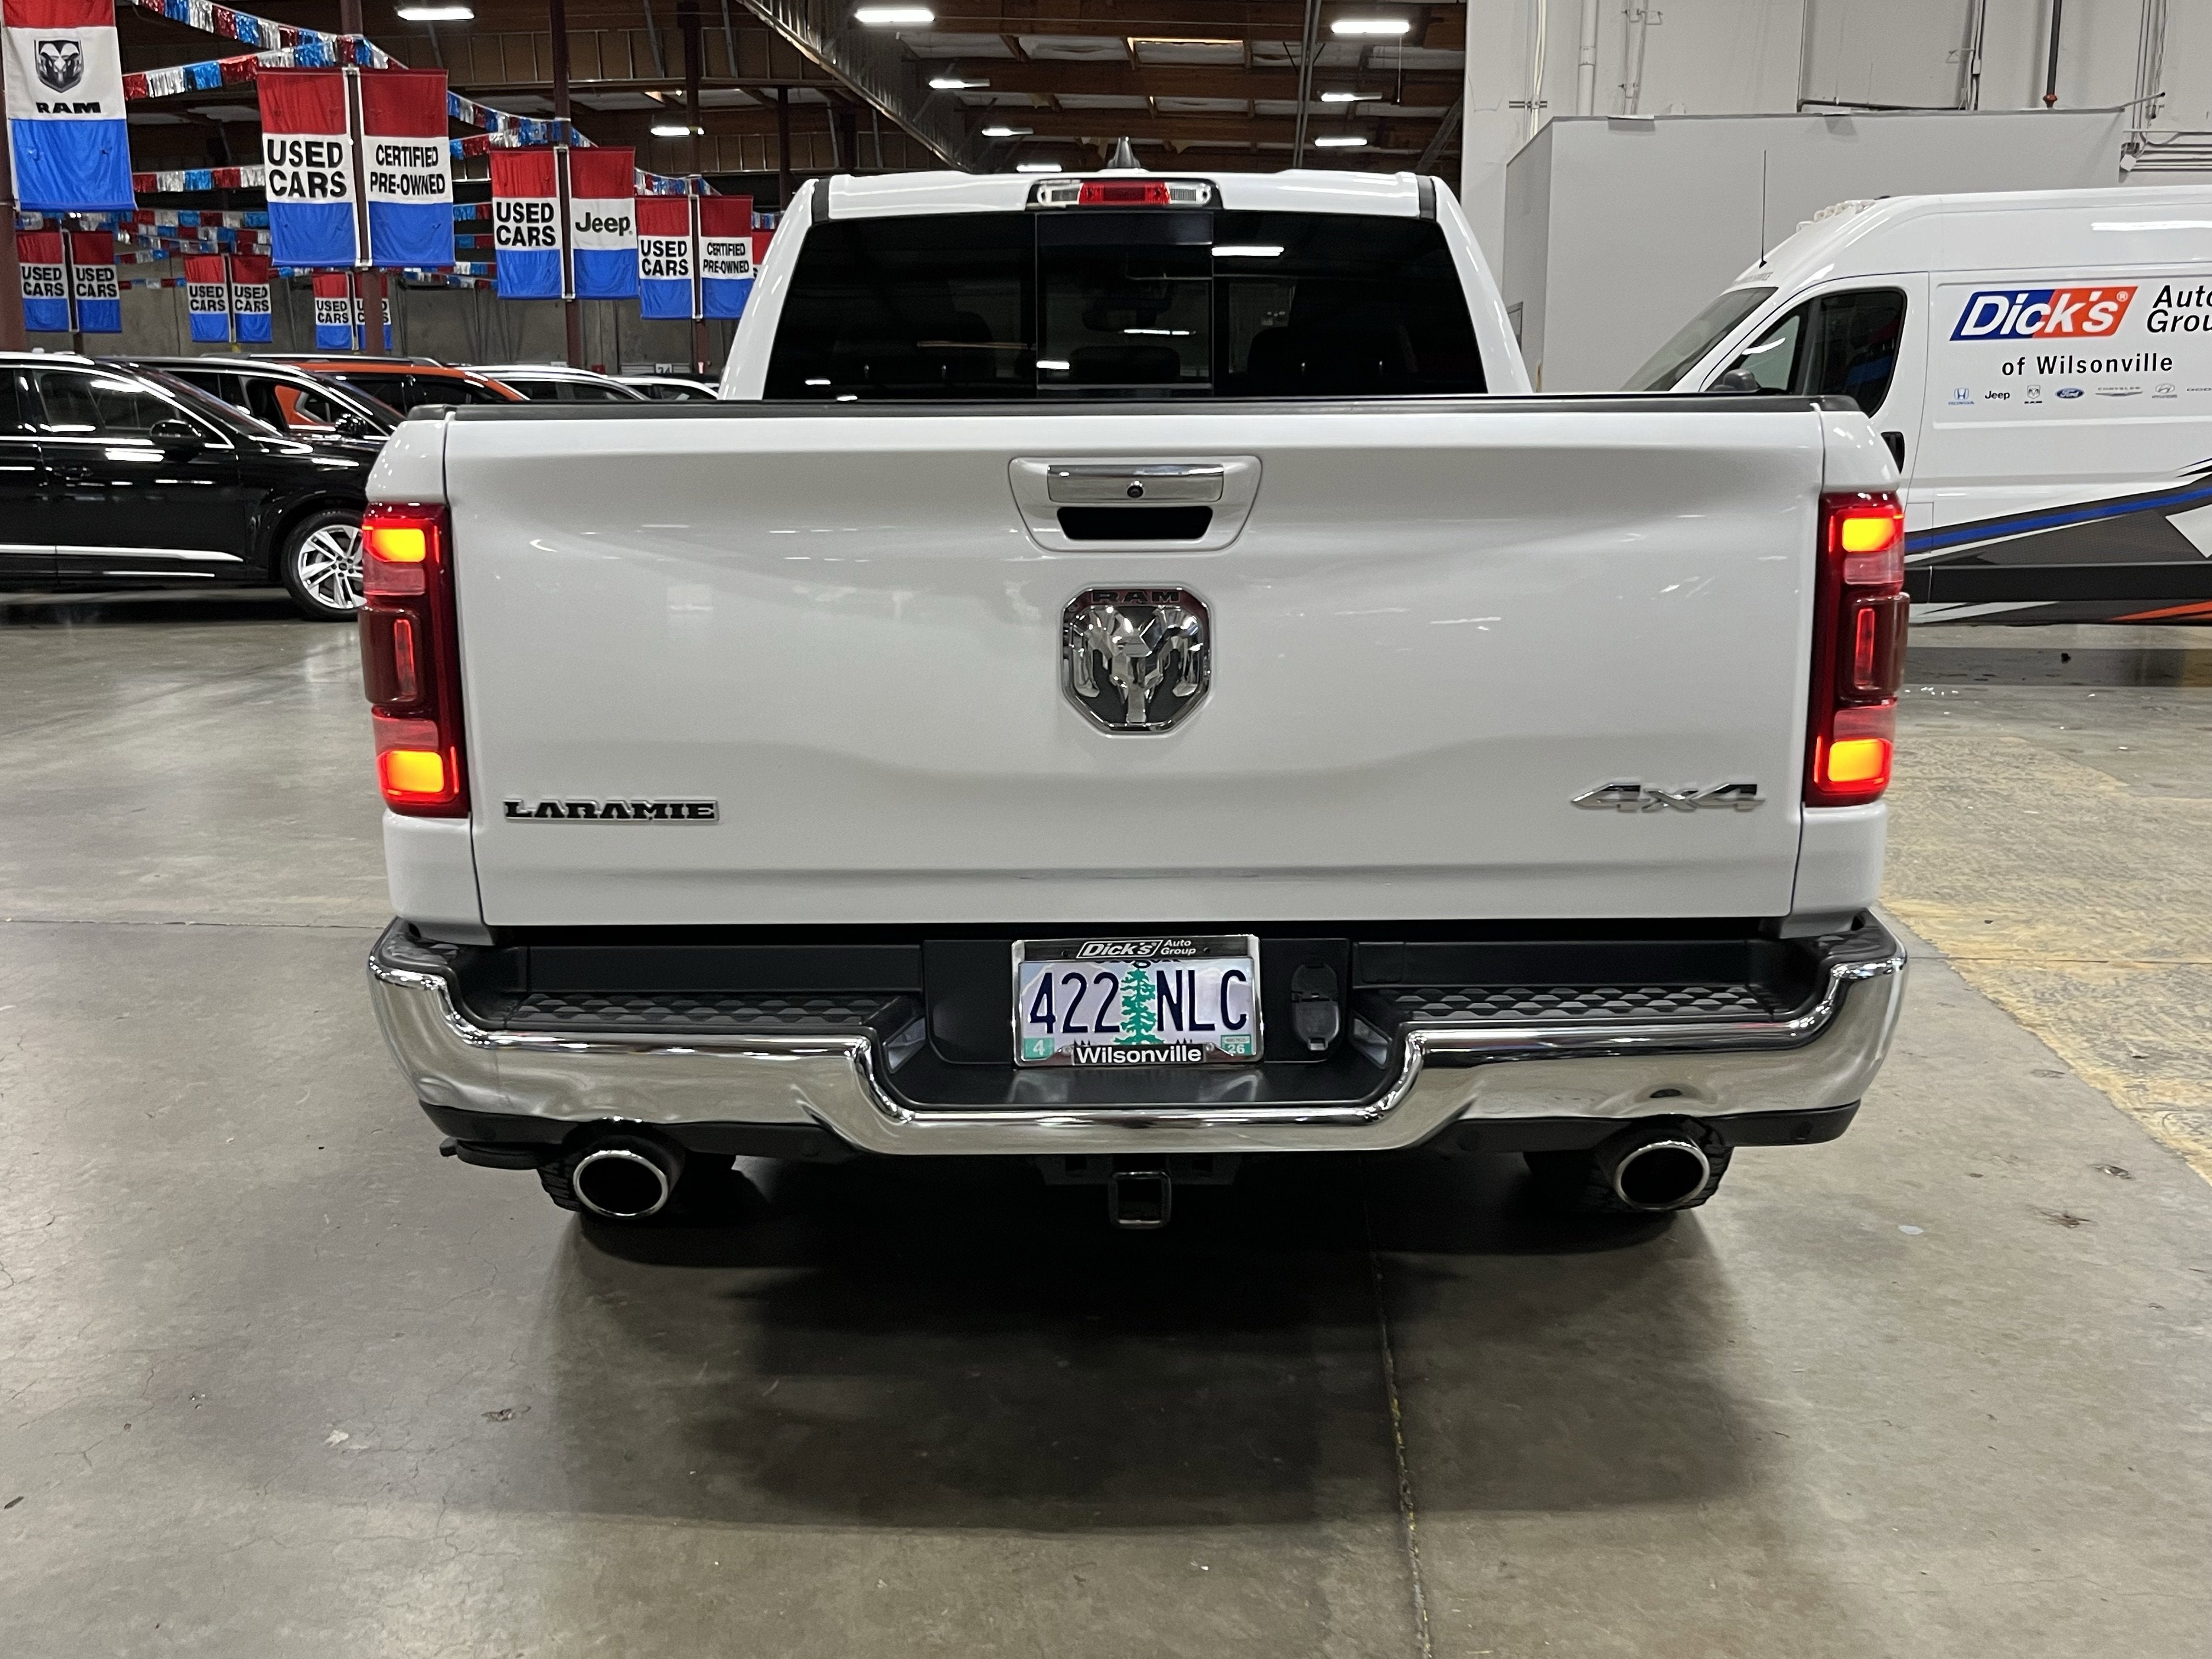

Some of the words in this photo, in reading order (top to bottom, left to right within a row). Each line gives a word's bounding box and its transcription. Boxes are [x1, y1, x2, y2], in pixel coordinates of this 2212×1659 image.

[36, 102, 101, 114] RAM
[267, 139, 343, 168] USED
[375, 144, 439, 167] CERTIFIED
[269, 169, 347, 198] CARS
[370, 172, 445, 195] PRE-OWNED
[496, 202, 554, 223] USED
[575, 212, 631, 236] Jeep
[496, 225, 556, 246] CARS
[641, 240, 687, 257] USED
[707, 242, 746, 256] CERTIFIED
[21, 266, 62, 280] USED
[642, 258, 689, 276] CARS
[703, 259, 749, 274] PRE-OWNED
[76, 268, 114, 281] USED
[23, 282, 64, 296] CARS
[76, 283, 117, 297] CARS
[189, 286, 224, 298] USED
[234, 286, 268, 298] USED
[190, 299, 225, 312] CARS
[235, 300, 269, 312] CARS
[316, 300, 347, 312] USED
[357, 301, 387, 311] UD
[318, 313, 348, 324] CARS
[358, 313, 389, 323] CS
[1961, 291, 2118, 336] Dick's
[2002, 357, 2025, 375] of
[2036, 353, 2172, 375] Wilsonville
[1984, 391, 2010, 400] Jeep
[1091, 590, 1180, 603] RAM
[503, 799, 719, 821] LARAMIE
[1160, 947, 1197, 956] Group
[1029, 971, 1120, 1034] 422
[1156, 969, 1247, 1031] NLC
[1032, 1040, 1045, 1056] 4
[1076, 1045, 1201, 1064] Wilsonville
[1228, 1044, 1245, 1054] 26
